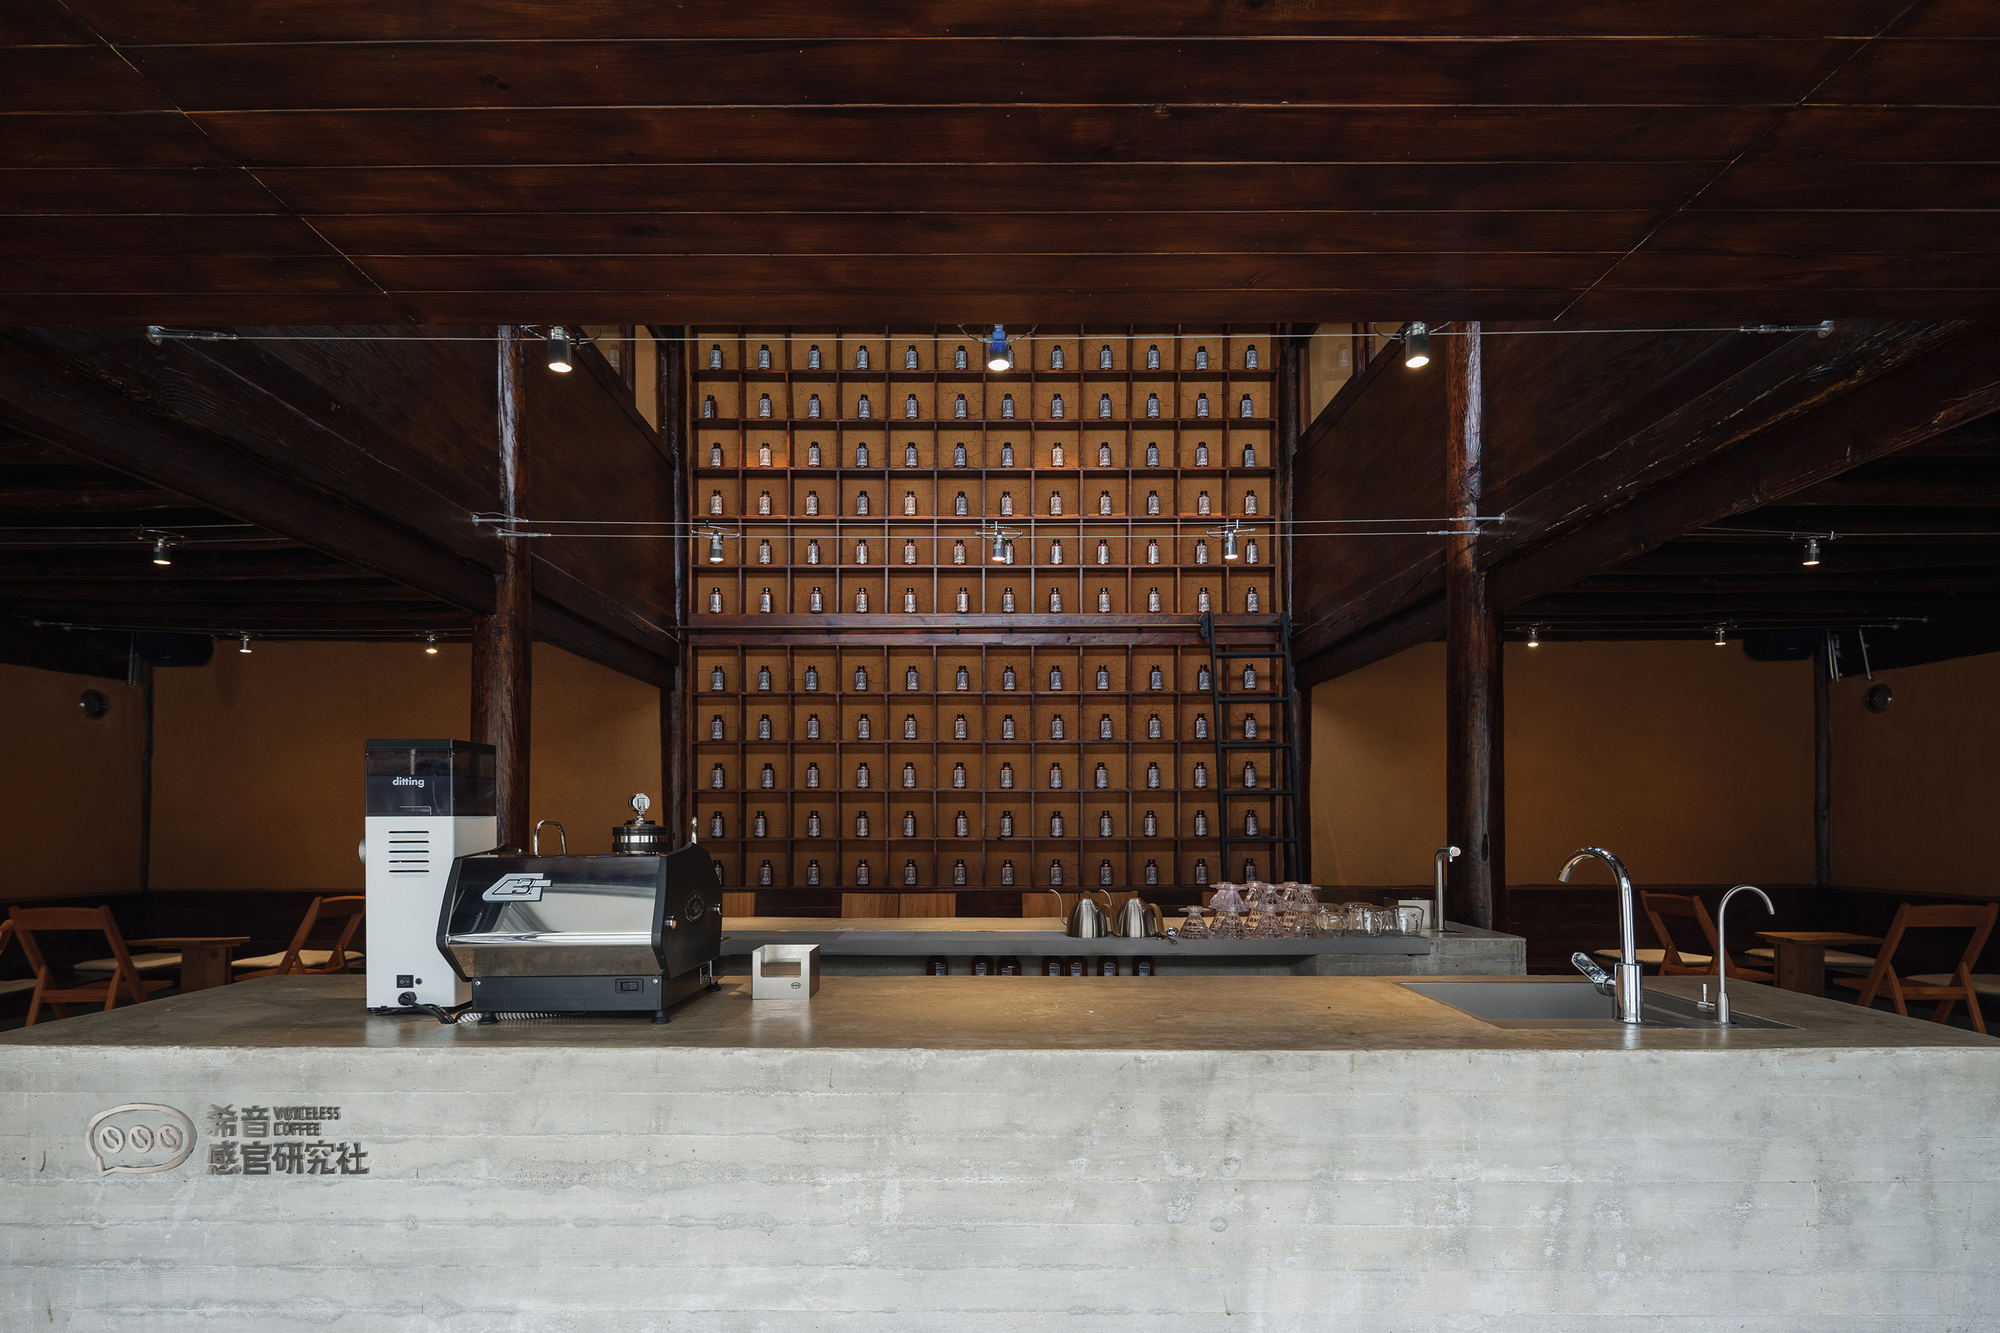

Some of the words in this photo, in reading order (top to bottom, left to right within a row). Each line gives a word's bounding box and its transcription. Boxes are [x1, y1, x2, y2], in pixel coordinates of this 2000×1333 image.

[392, 776, 425, 788] ditting
[205, 1103, 271, 1138] 希音
[274, 1121, 322, 1136] COFFEE
[206, 1140, 370, 1175] 感官研究社
